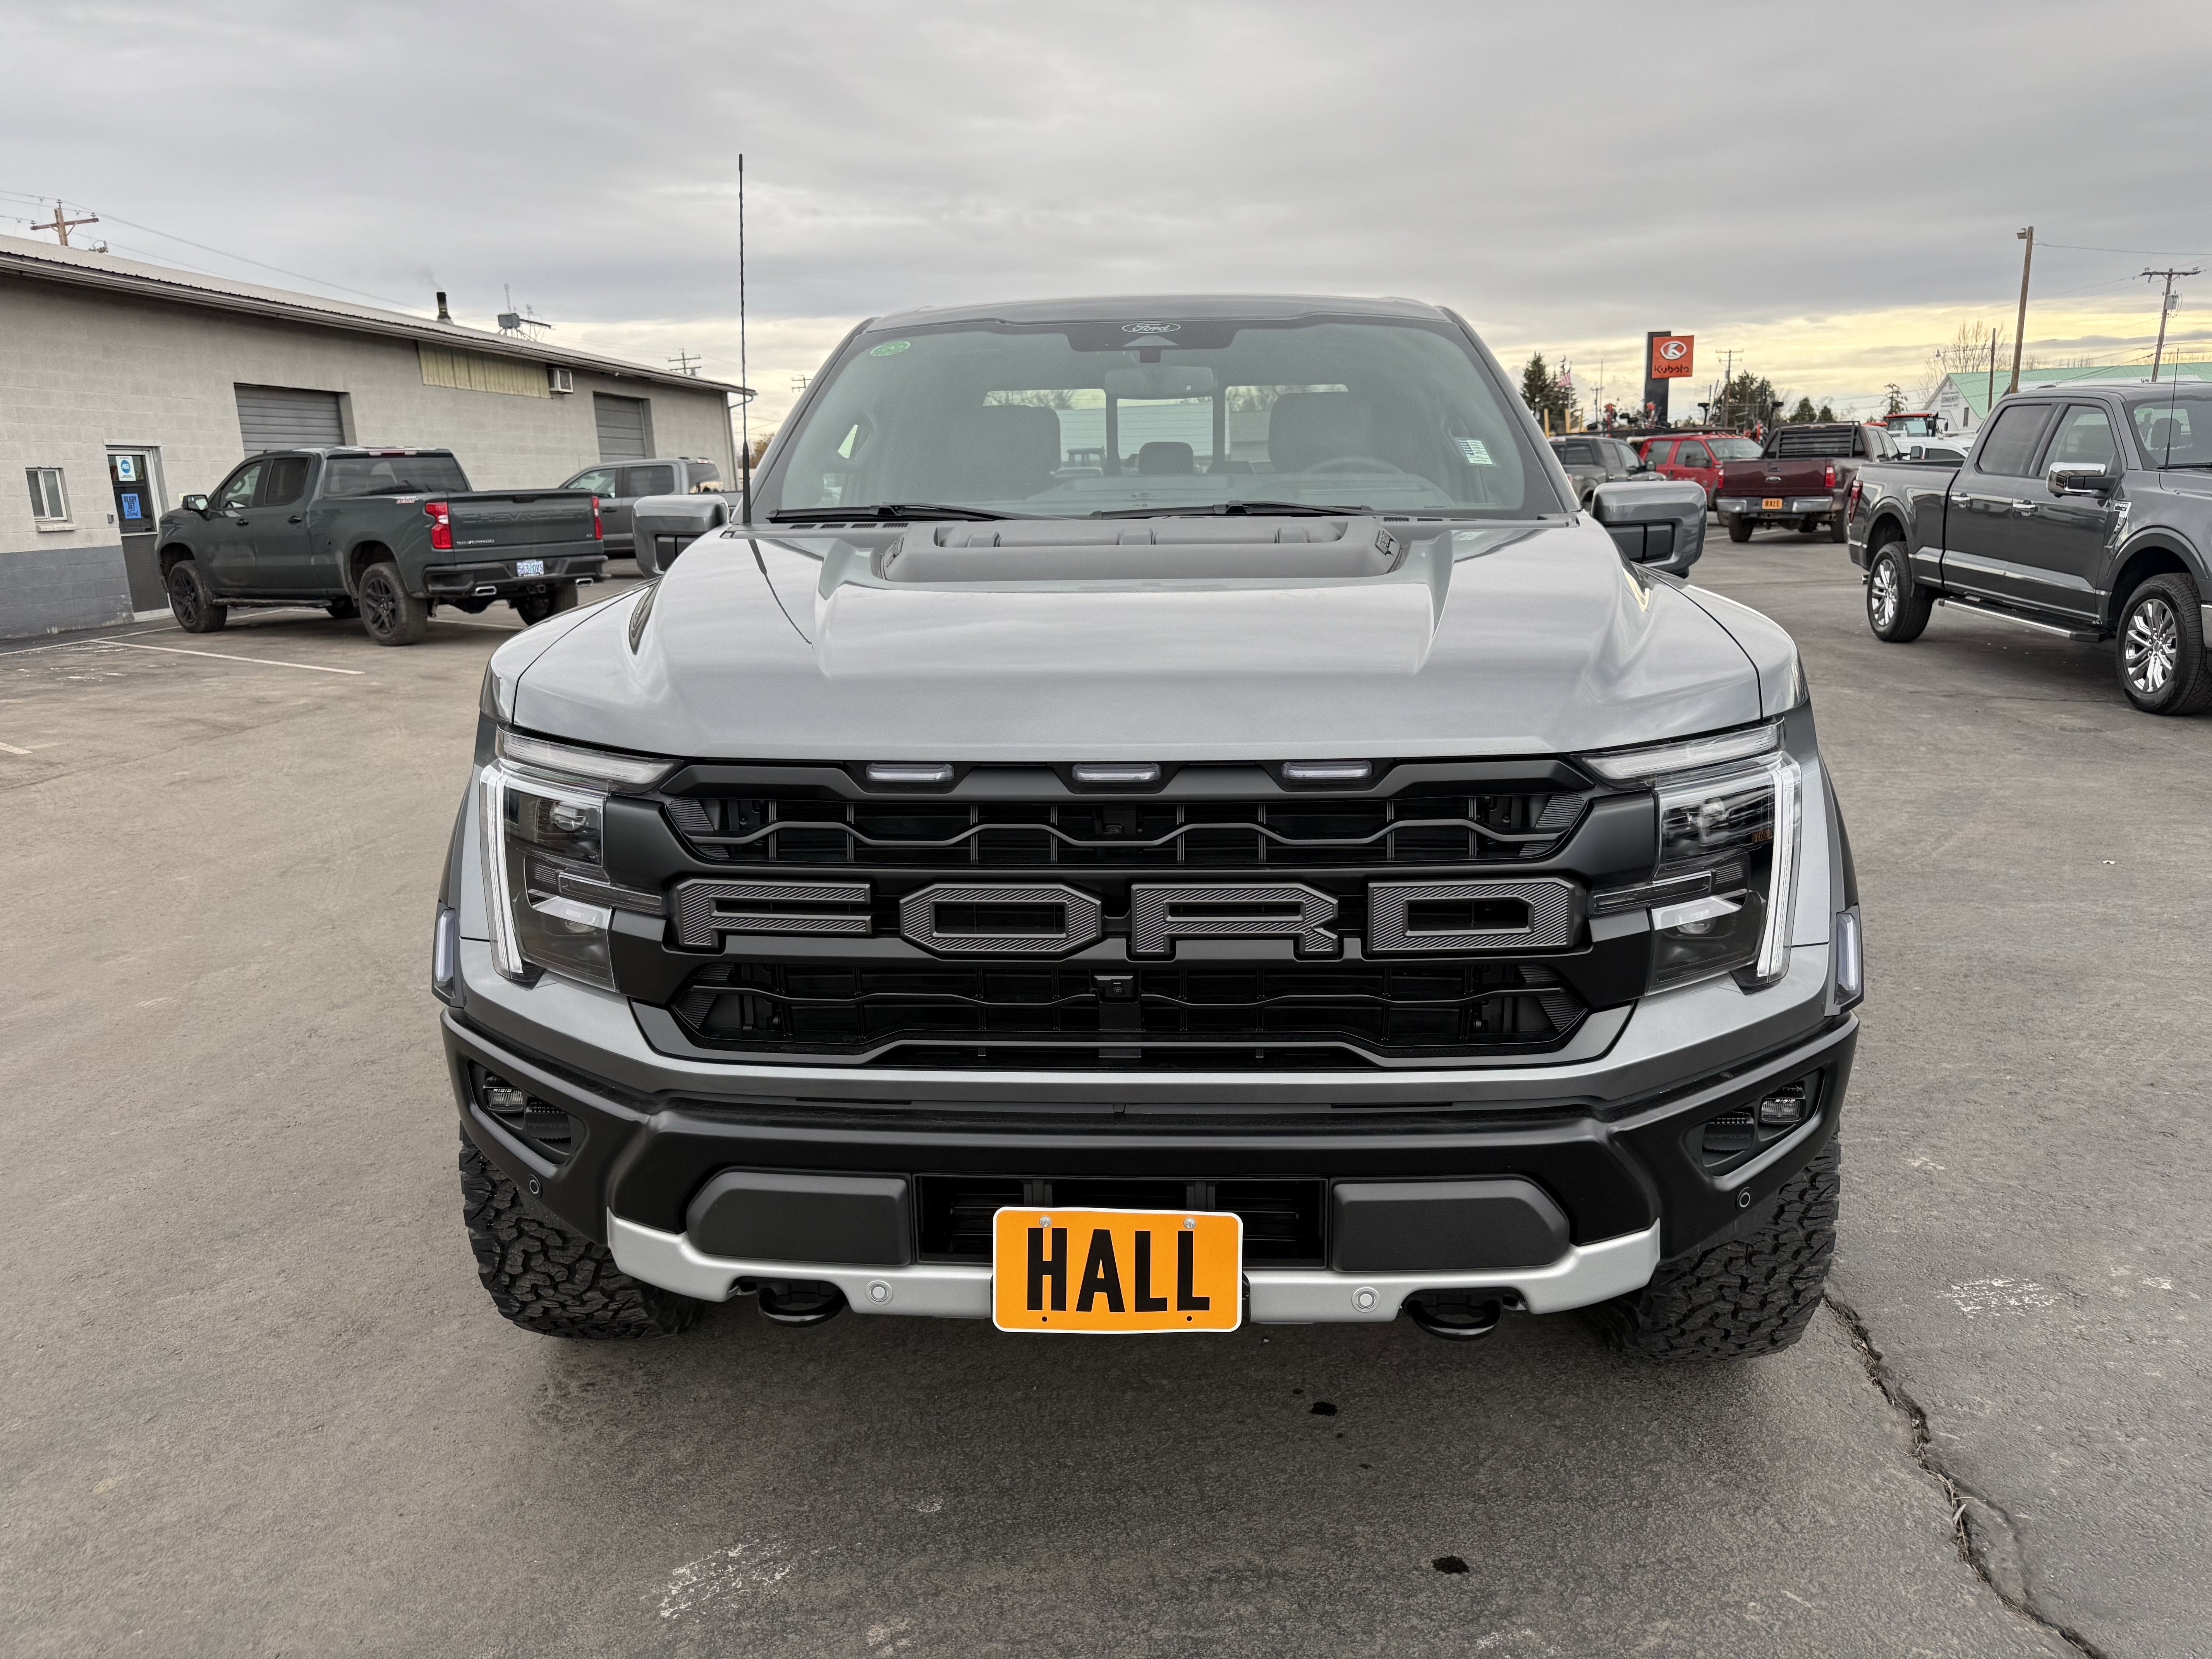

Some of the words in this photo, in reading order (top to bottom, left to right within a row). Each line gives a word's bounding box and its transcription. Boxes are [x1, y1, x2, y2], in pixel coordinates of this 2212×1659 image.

[1132, 323, 1170, 331] Ford
[1654, 364, 1689, 374] Kubota
[677, 877, 1575, 955] FORD
[1027, 1228, 1210, 1312] HALL
